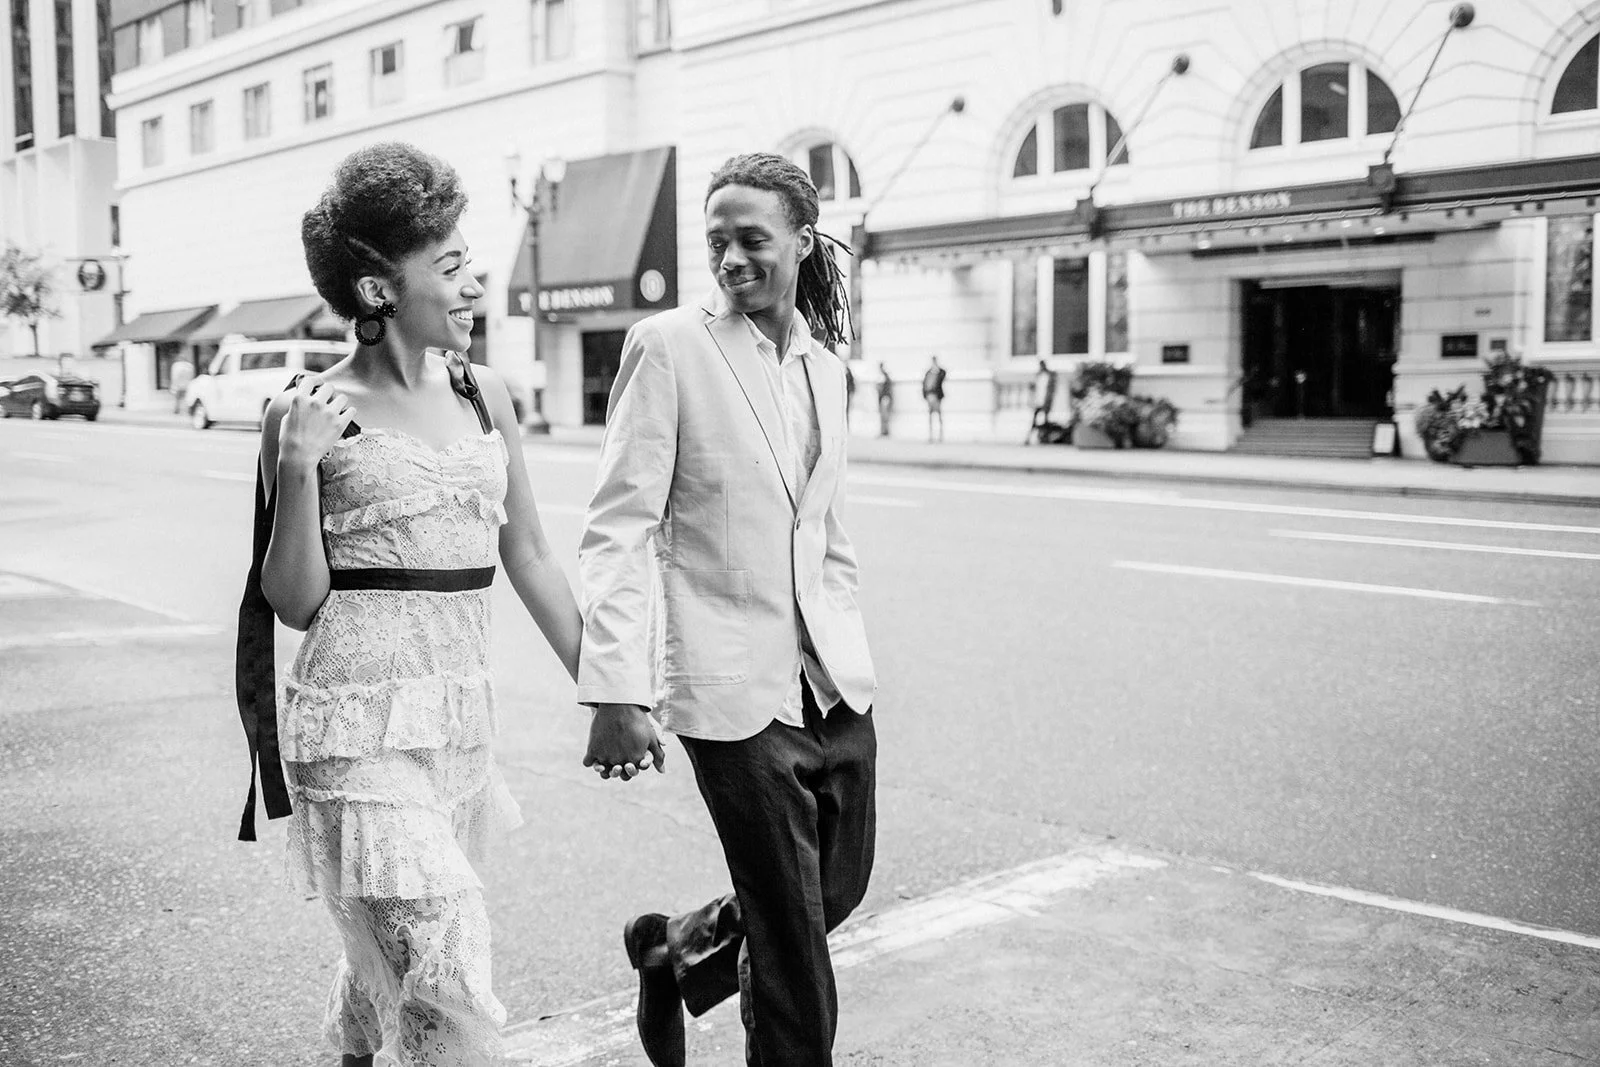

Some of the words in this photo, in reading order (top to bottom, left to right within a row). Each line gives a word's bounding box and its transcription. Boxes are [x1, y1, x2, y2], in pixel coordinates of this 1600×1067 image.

[1172, 202, 1209, 218] THE
[1213, 192, 1291, 214] BENSON
[519, 291, 550, 312] TE
[551, 287, 613, 310] BENSON
